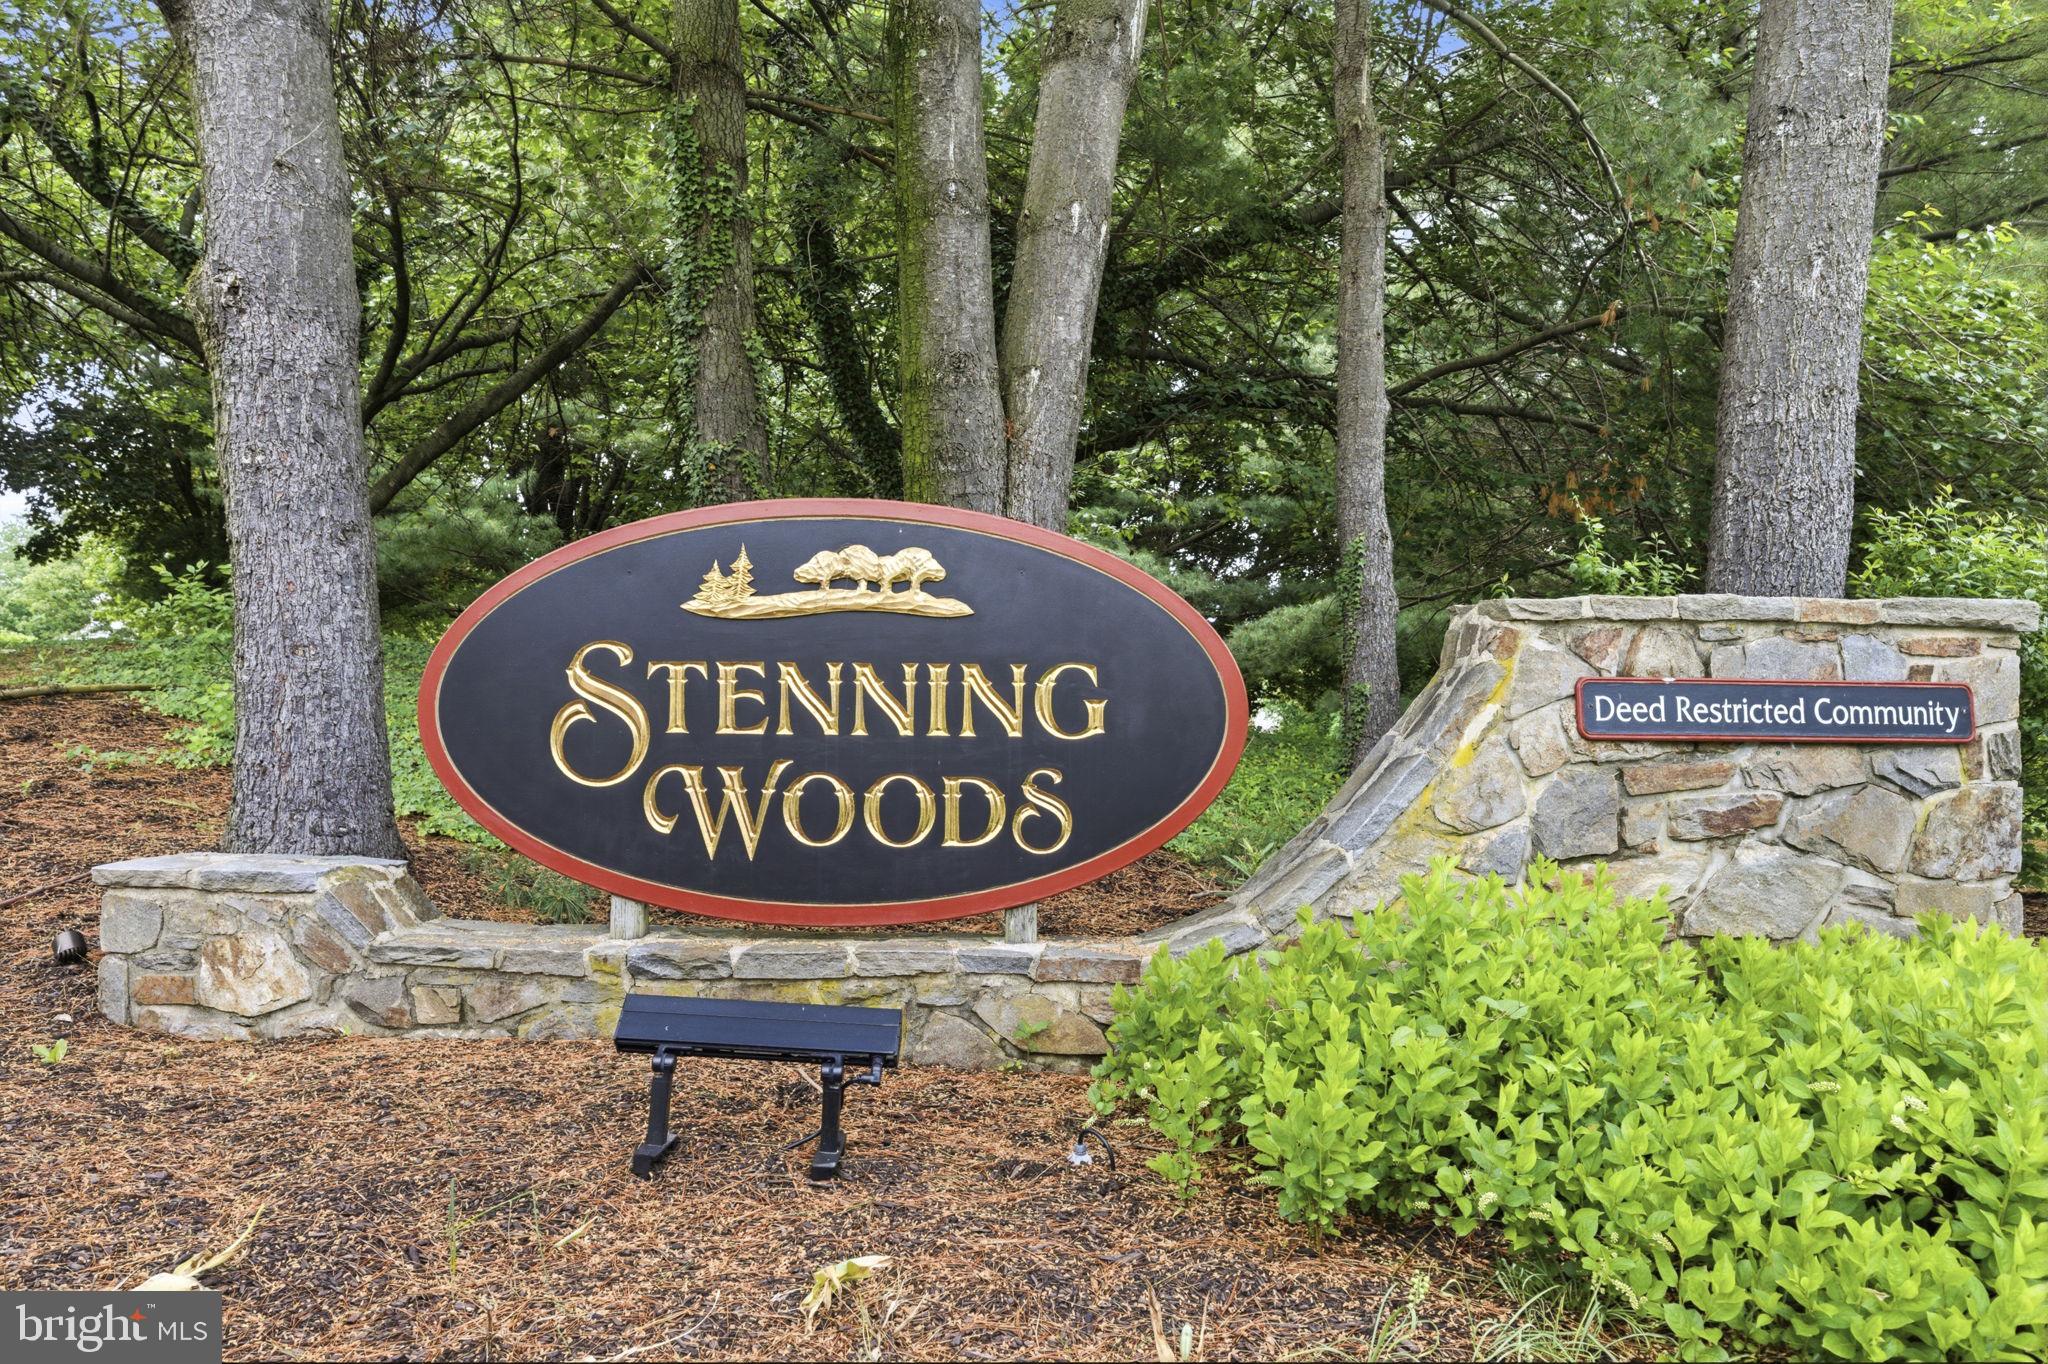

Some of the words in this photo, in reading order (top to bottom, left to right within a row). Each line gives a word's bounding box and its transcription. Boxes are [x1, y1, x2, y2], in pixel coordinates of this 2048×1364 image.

[550, 640, 1108, 787] STENNING
[1594, 695, 1666, 723] Deed
[1676, 696, 1804, 725] Restricted
[1813, 698, 1960, 733] Community
[643, 759, 1073, 862] WOODS
